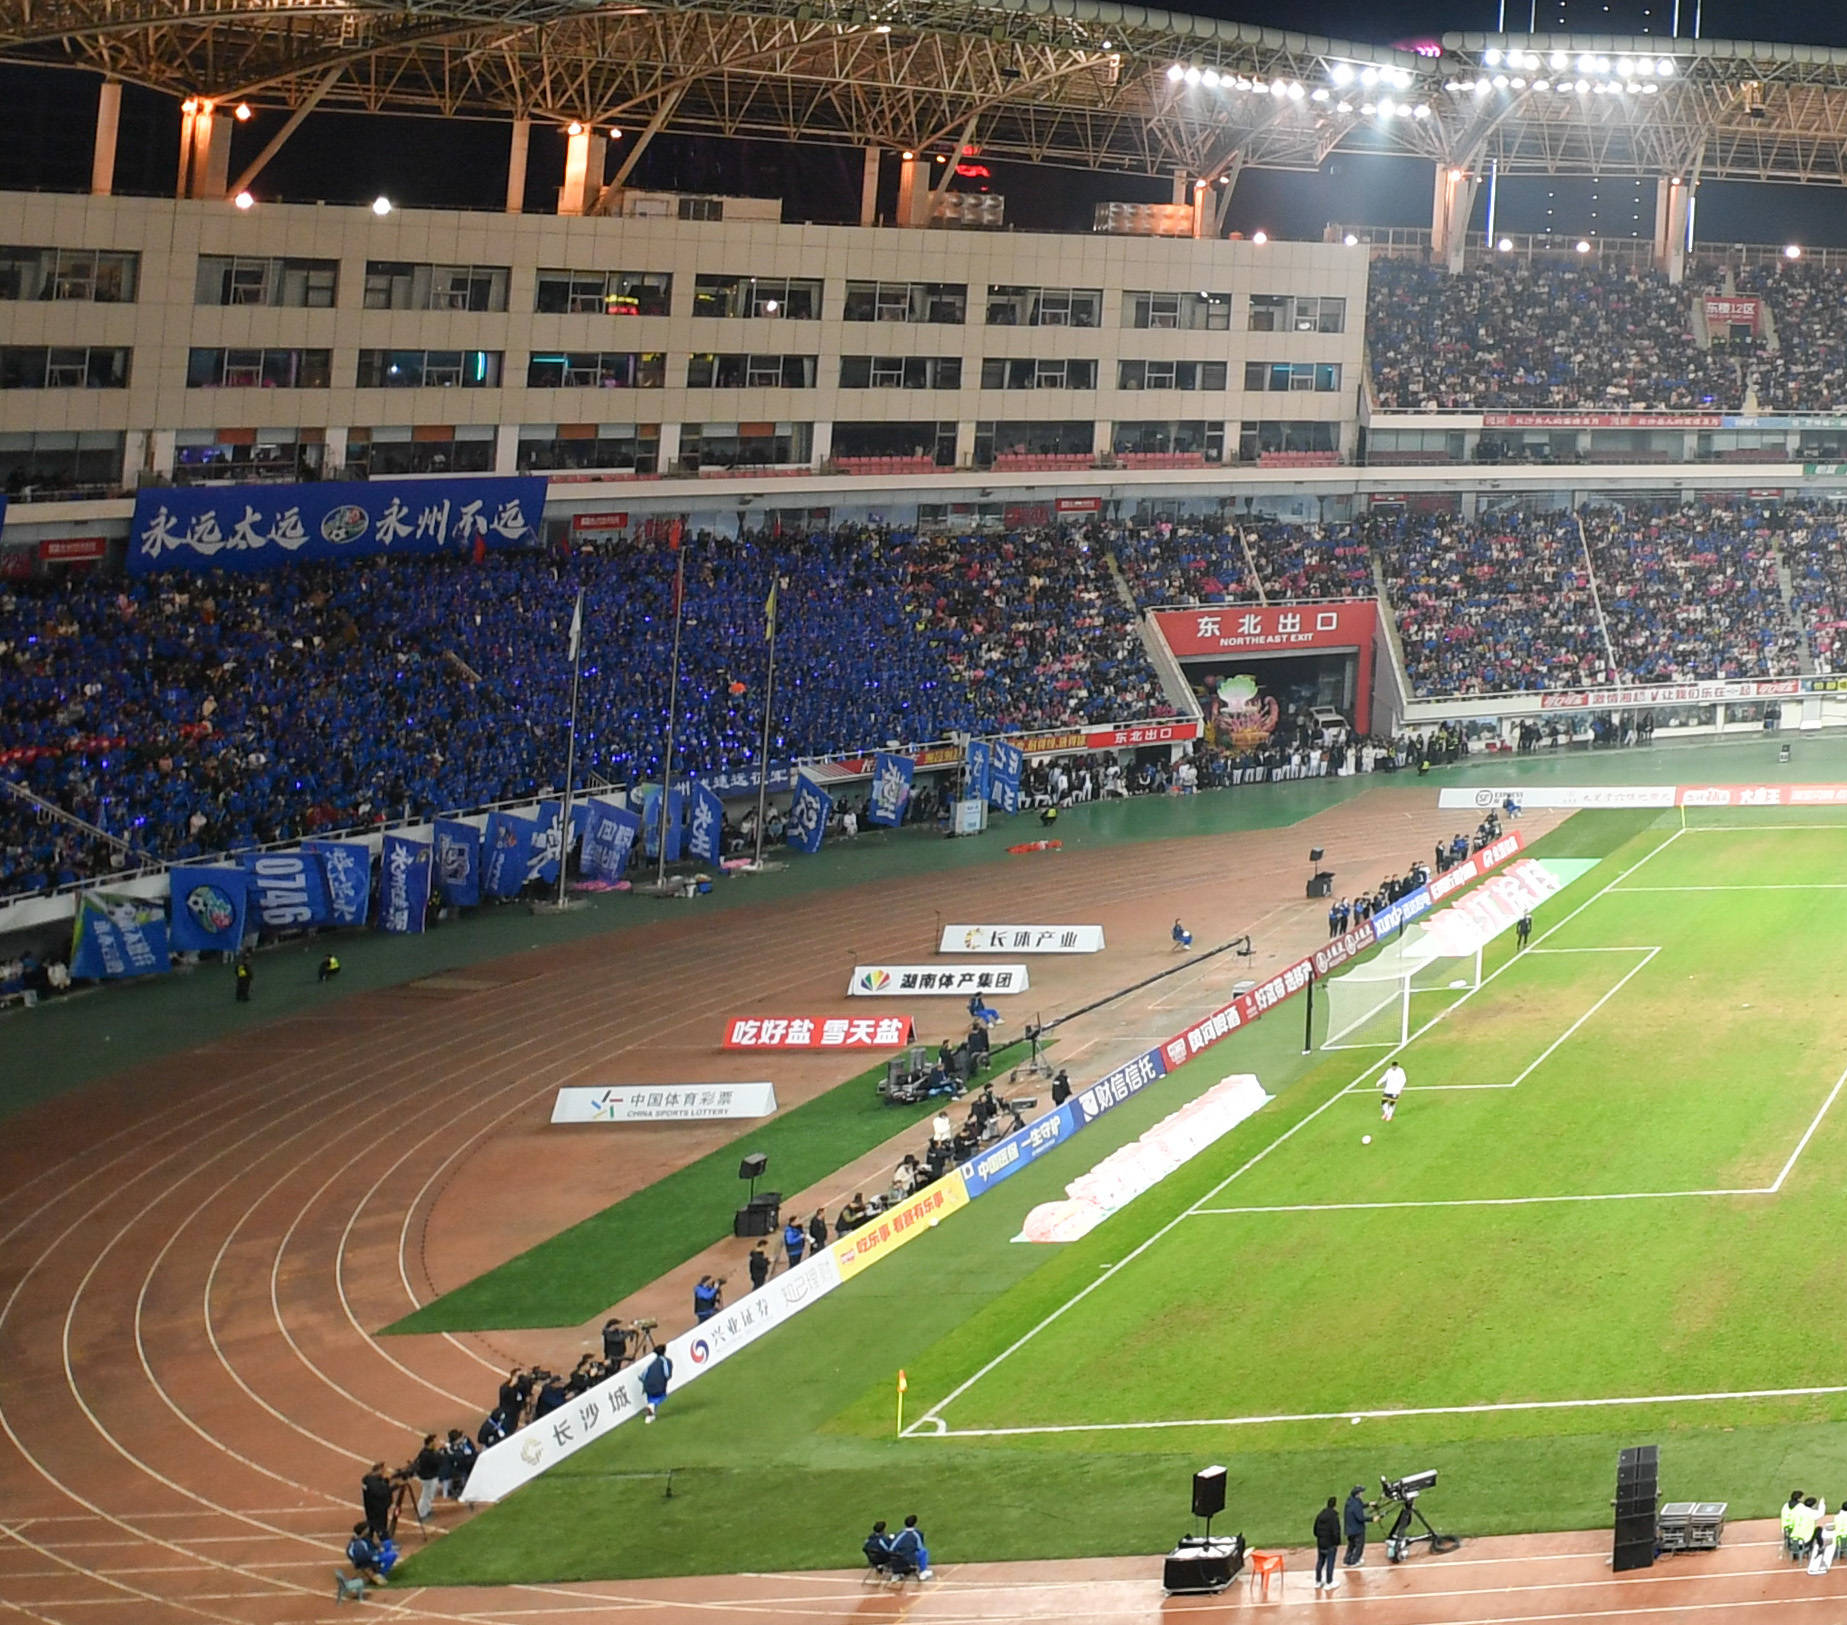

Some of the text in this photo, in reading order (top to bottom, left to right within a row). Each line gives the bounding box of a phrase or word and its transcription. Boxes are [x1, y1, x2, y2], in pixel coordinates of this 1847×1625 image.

[141, 497, 529, 559] 永远太远 永州不远
[1197, 612, 1338, 638] 东北出口
[1219, 632, 1314, 647] NORTHEAST EXIT
[1114, 727, 1173, 745] 东北出口
[255, 857, 313, 925] 0746
[899, 972, 1013, 990] 湖南体产集团
[731, 1018, 904, 1045] 吃好盐 雪天盐
[1095, 1055, 1156, 1114] 财信信托
[630, 1090, 736, 1109] 中国体育彩票
[654, 1108, 689, 1118] SPORTS
[690, 1107, 730, 1117] LOTTERY
